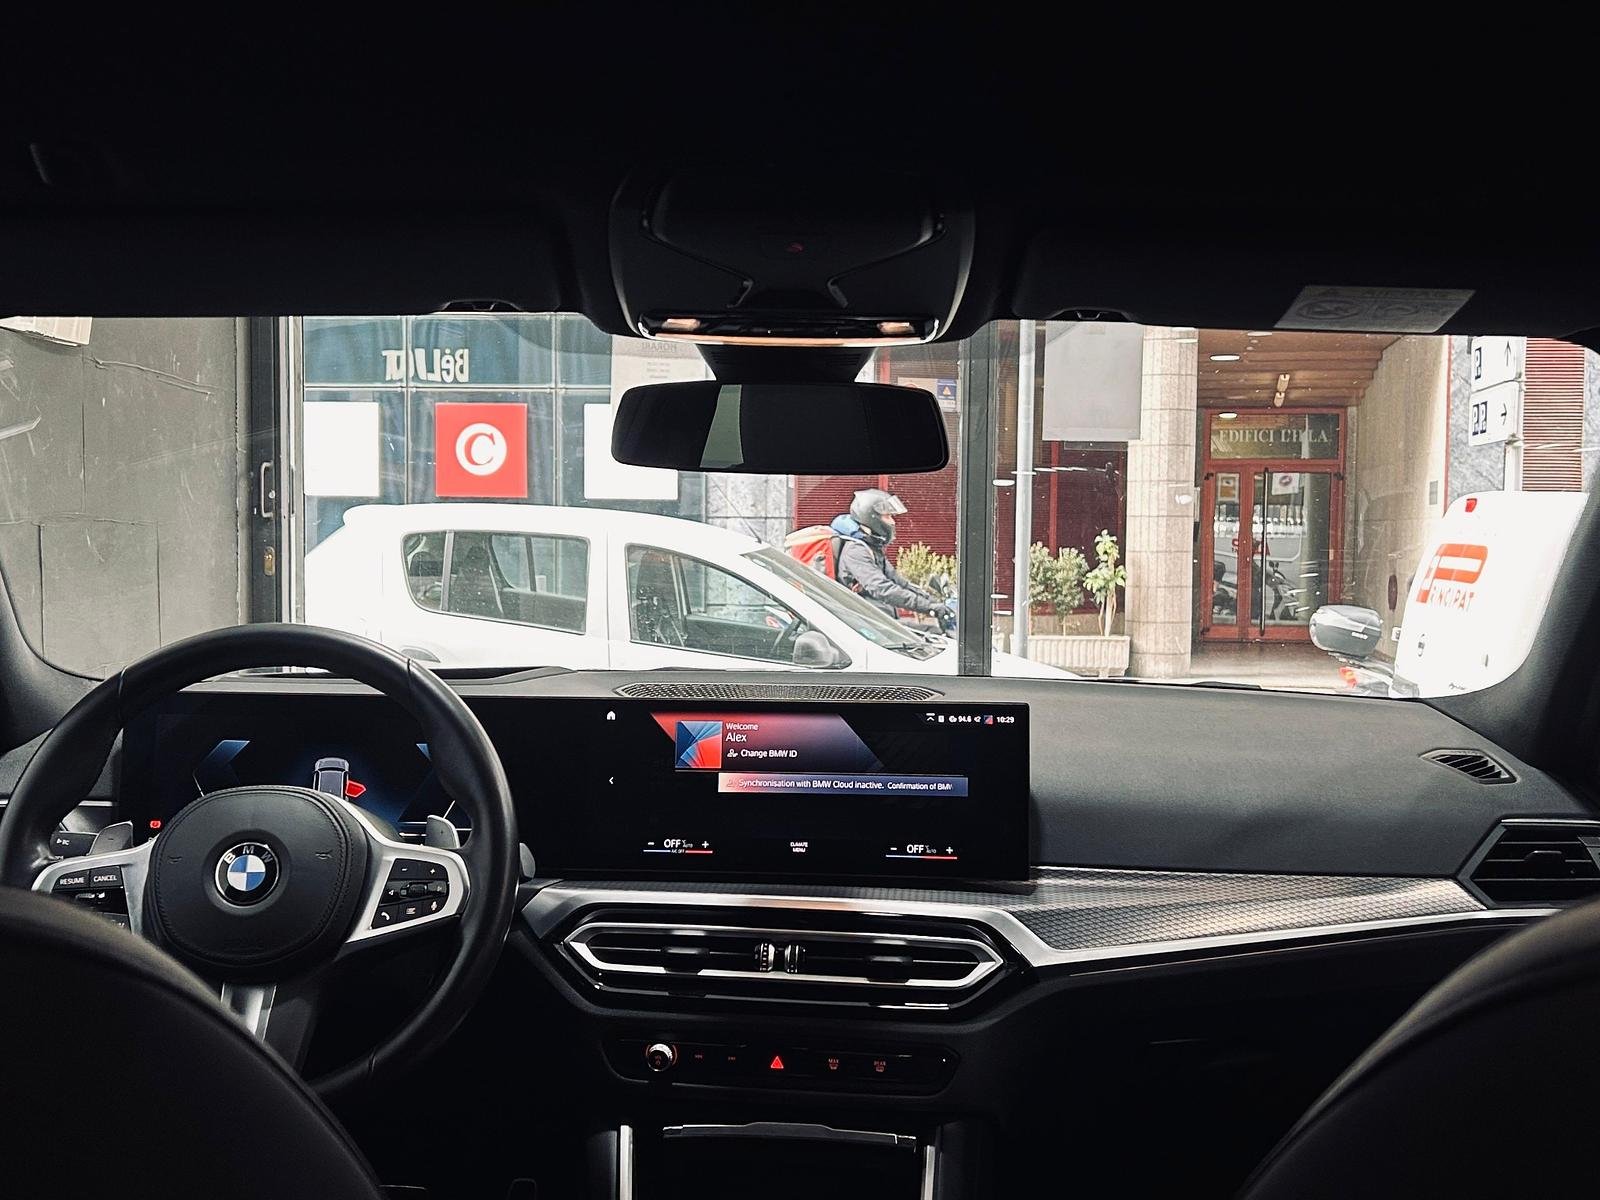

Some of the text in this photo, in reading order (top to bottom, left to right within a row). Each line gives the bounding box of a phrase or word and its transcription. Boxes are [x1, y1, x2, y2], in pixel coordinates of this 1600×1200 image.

[1220, 429, 1274, 443] EDIFICI
[725, 722, 759, 731] Welcome
[725, 732, 747, 742] Alex
[740, 748, 798, 759] Change BMW ID
[739, 779, 795, 788] Synchronisation
[796, 779, 811, 788] with
[812, 780, 831, 788] BMW
[832, 780, 854, 789] Cloud
[887, 782, 929, 790] Confirmation
[929, 782, 937, 790] of
[663, 838, 682, 849] OFF
[906, 844, 925, 854] OFF
[223, 845, 274, 865] BMW
[60, 874, 118, 886] RESUME CANCEL
